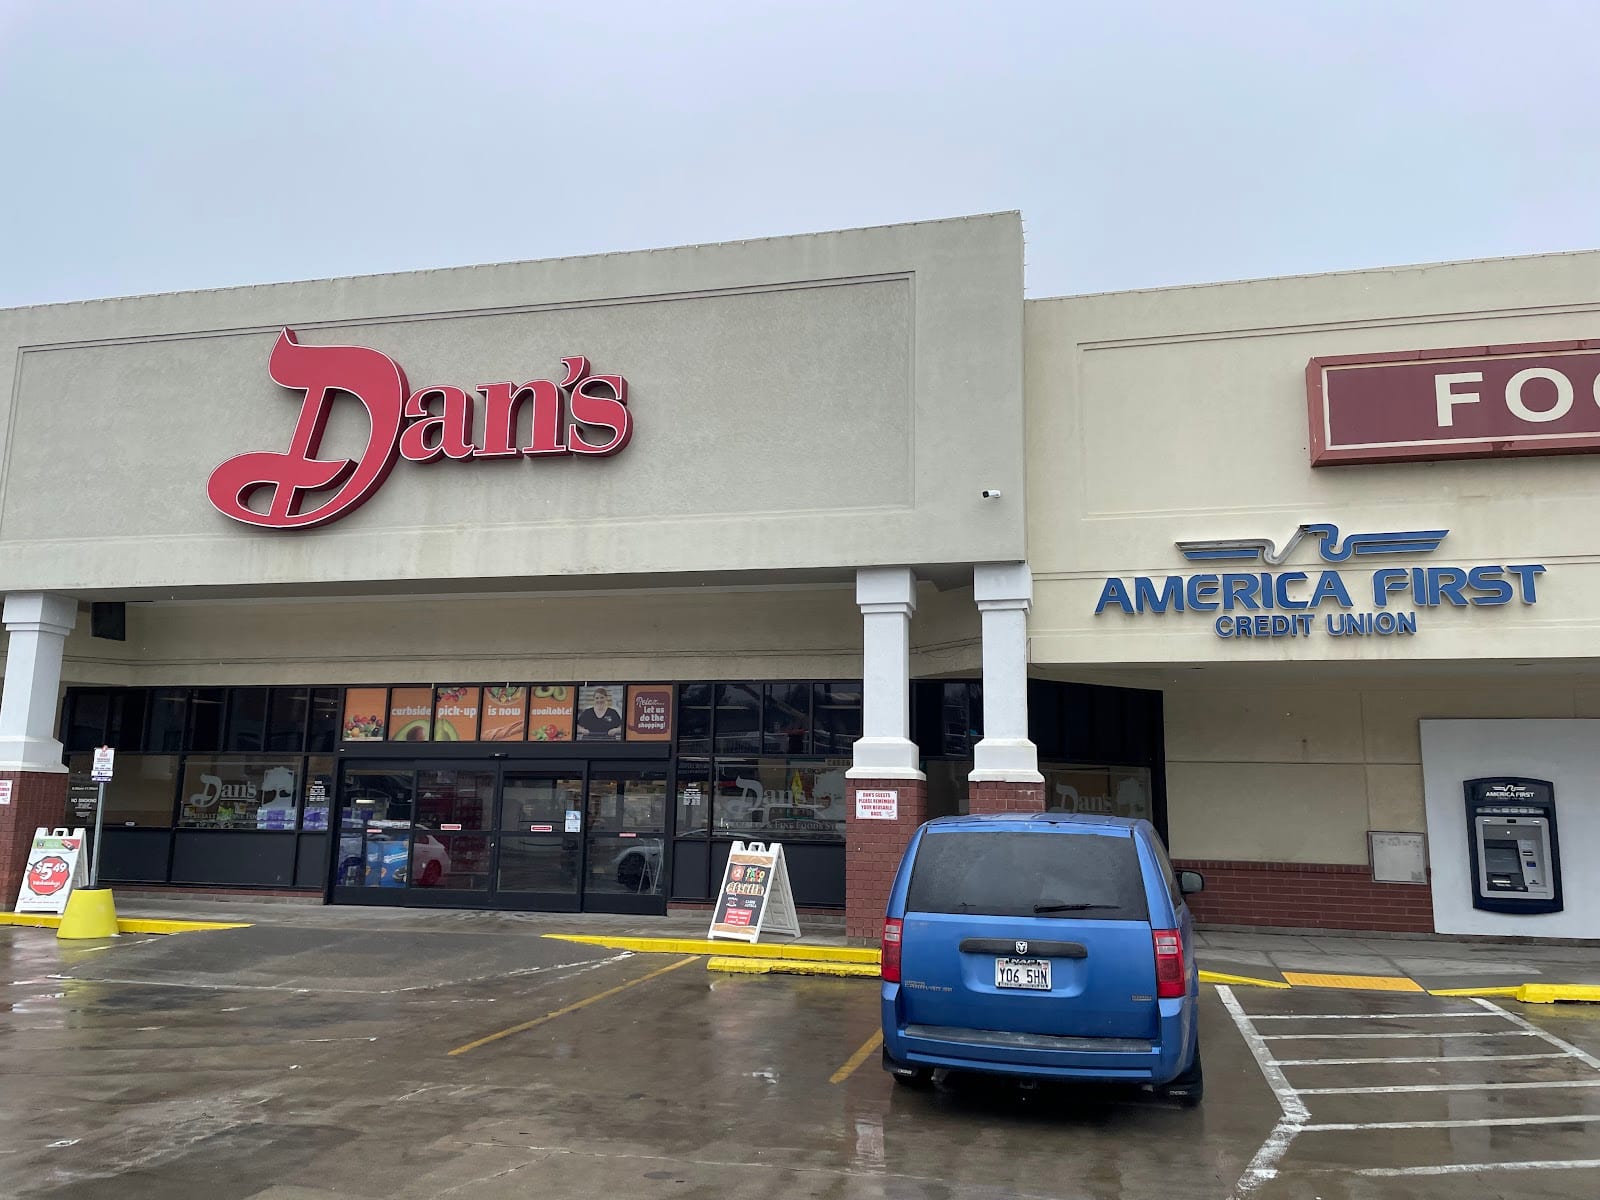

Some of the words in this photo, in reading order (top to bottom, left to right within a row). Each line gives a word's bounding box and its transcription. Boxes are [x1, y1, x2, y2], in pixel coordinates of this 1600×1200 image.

[1434, 366, 1600, 428] FO
[206, 325, 632, 530] Dan's
[1094, 570, 1354, 615] AMERICA
[1373, 564, 1547, 608] FIRST
[1214, 612, 1316, 640] CREDIT
[1327, 611, 1418, 637] UNION
[391, 705, 432, 716] curbside
[437, 705, 477, 719] pick-up
[488, 705, 497, 716] is
[499, 706, 521, 716] now
[531, 706, 573, 716] available!
[638, 722, 666, 730] shopping!
[639, 714, 651, 722] do
[651, 714, 665, 722] the
[190, 773, 258, 808] Dan's
[720, 776, 807, 814] Dans
[746, 867, 766, 880] TACO
[1026, 969, 1047, 985] 5HN
